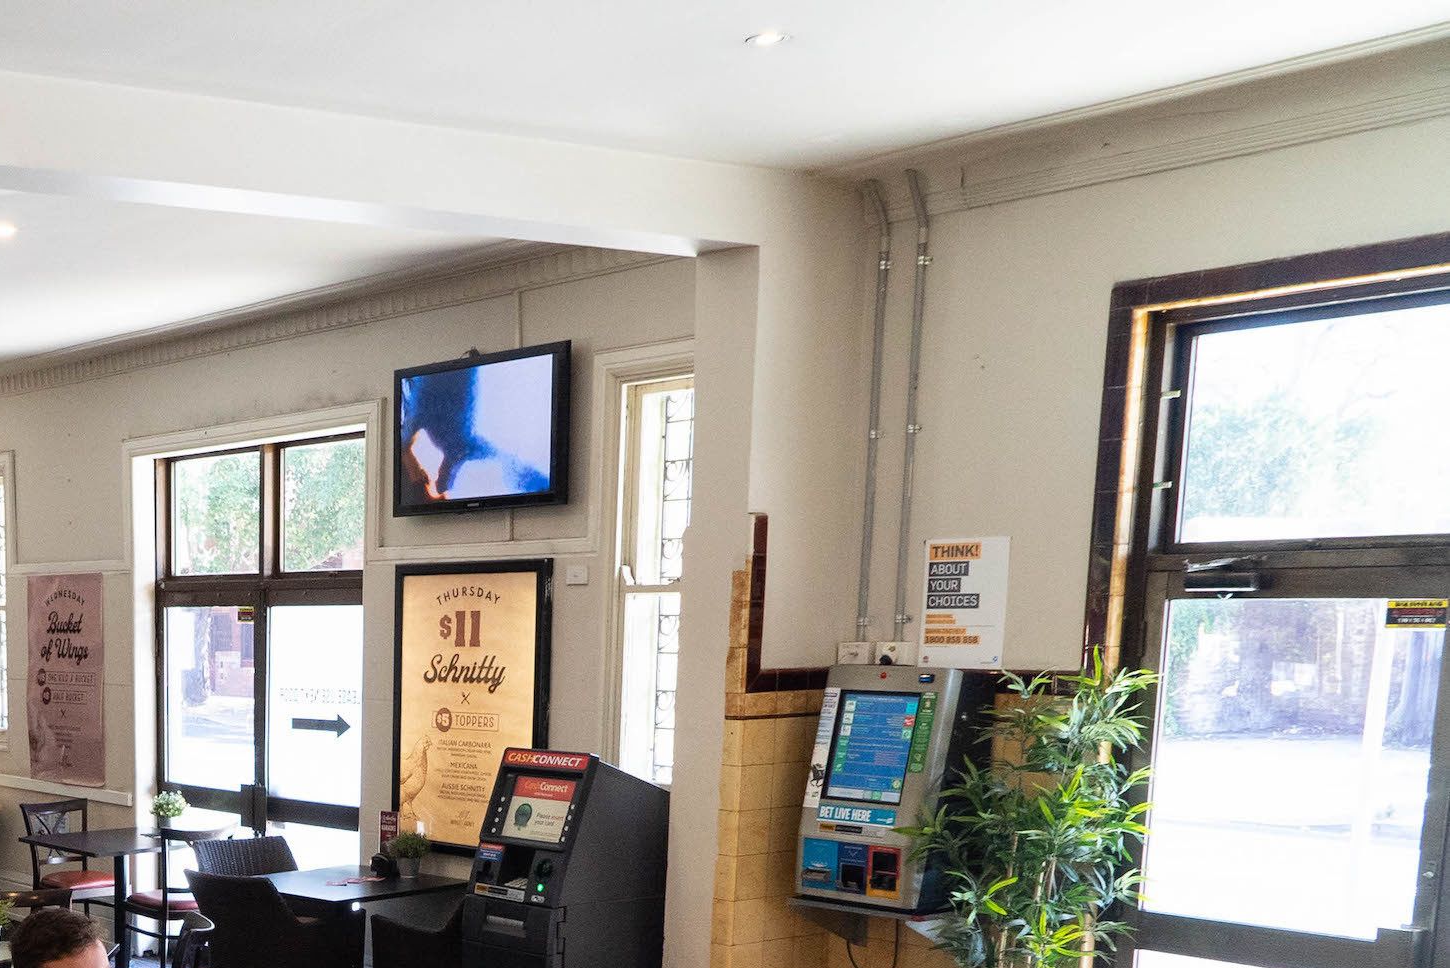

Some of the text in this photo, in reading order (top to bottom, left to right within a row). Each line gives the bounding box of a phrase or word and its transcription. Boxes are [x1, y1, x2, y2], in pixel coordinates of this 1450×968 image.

[932, 544, 979, 558] THINK!
[930, 563, 967, 575] ABOUT
[930, 580, 958, 591] YOUR
[45, 590, 85, 606] WEDNESDAY
[436, 586, 501, 605] THURSDAY
[928, 595, 978, 607] CHOICES
[46, 611, 84, 635] Bucket
[439, 610, 481, 647] $11
[40, 638, 89, 666] of Wings
[423, 653, 506, 694] Schnitty
[455, 714, 495, 728] TOPPERS
[450, 762, 478, 770] MEXICANA
[508, 752, 583, 767] CASHCONNECT
[819, 806, 872, 822] BET LIVE HERE
